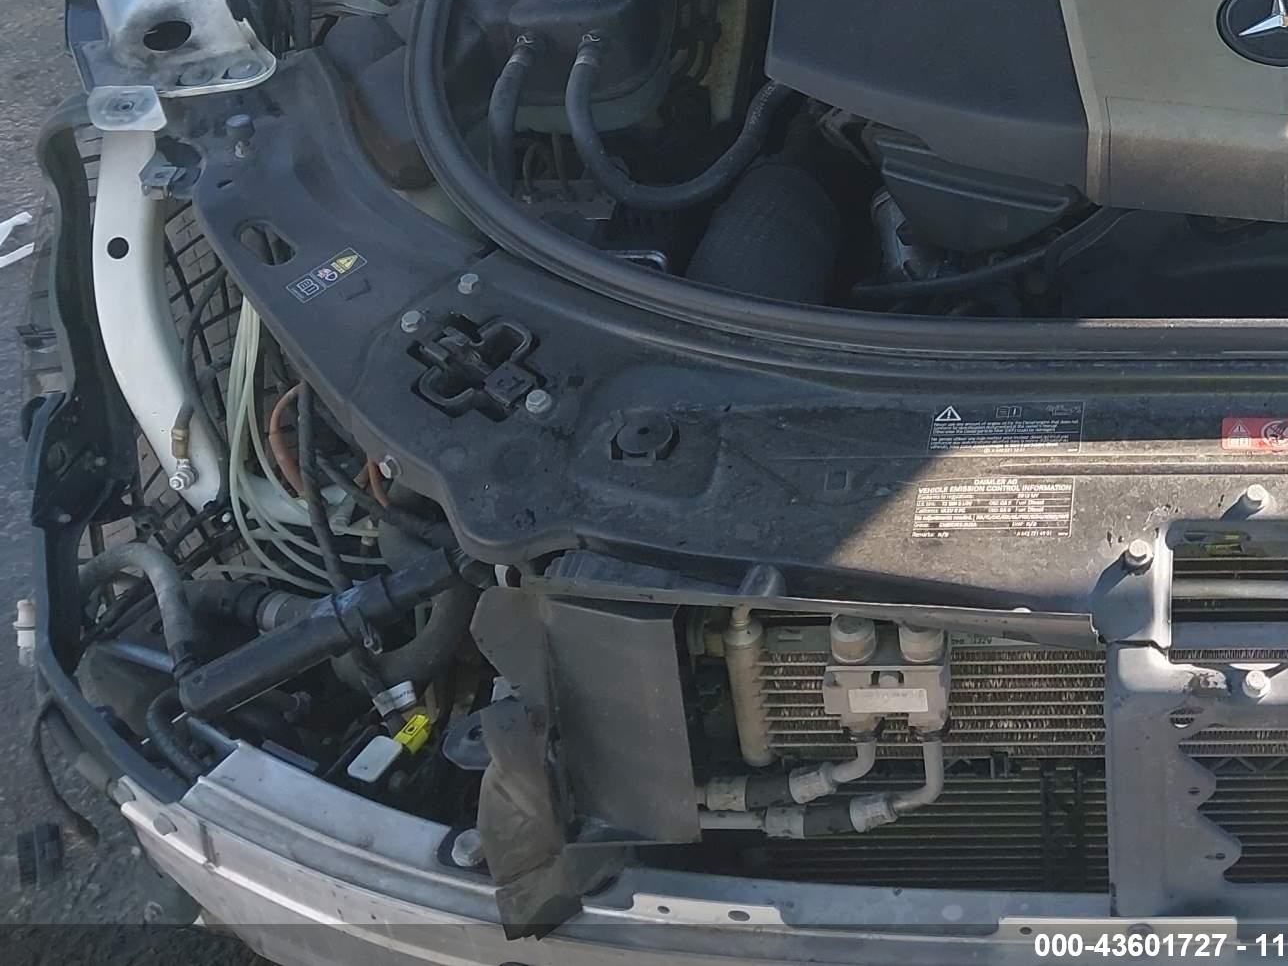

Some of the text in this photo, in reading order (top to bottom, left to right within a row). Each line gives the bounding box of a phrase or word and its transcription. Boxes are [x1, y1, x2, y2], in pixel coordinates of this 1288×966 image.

[918, 483, 1072, 494] VEHICLE EMISSION CONTROL INFORMATION
